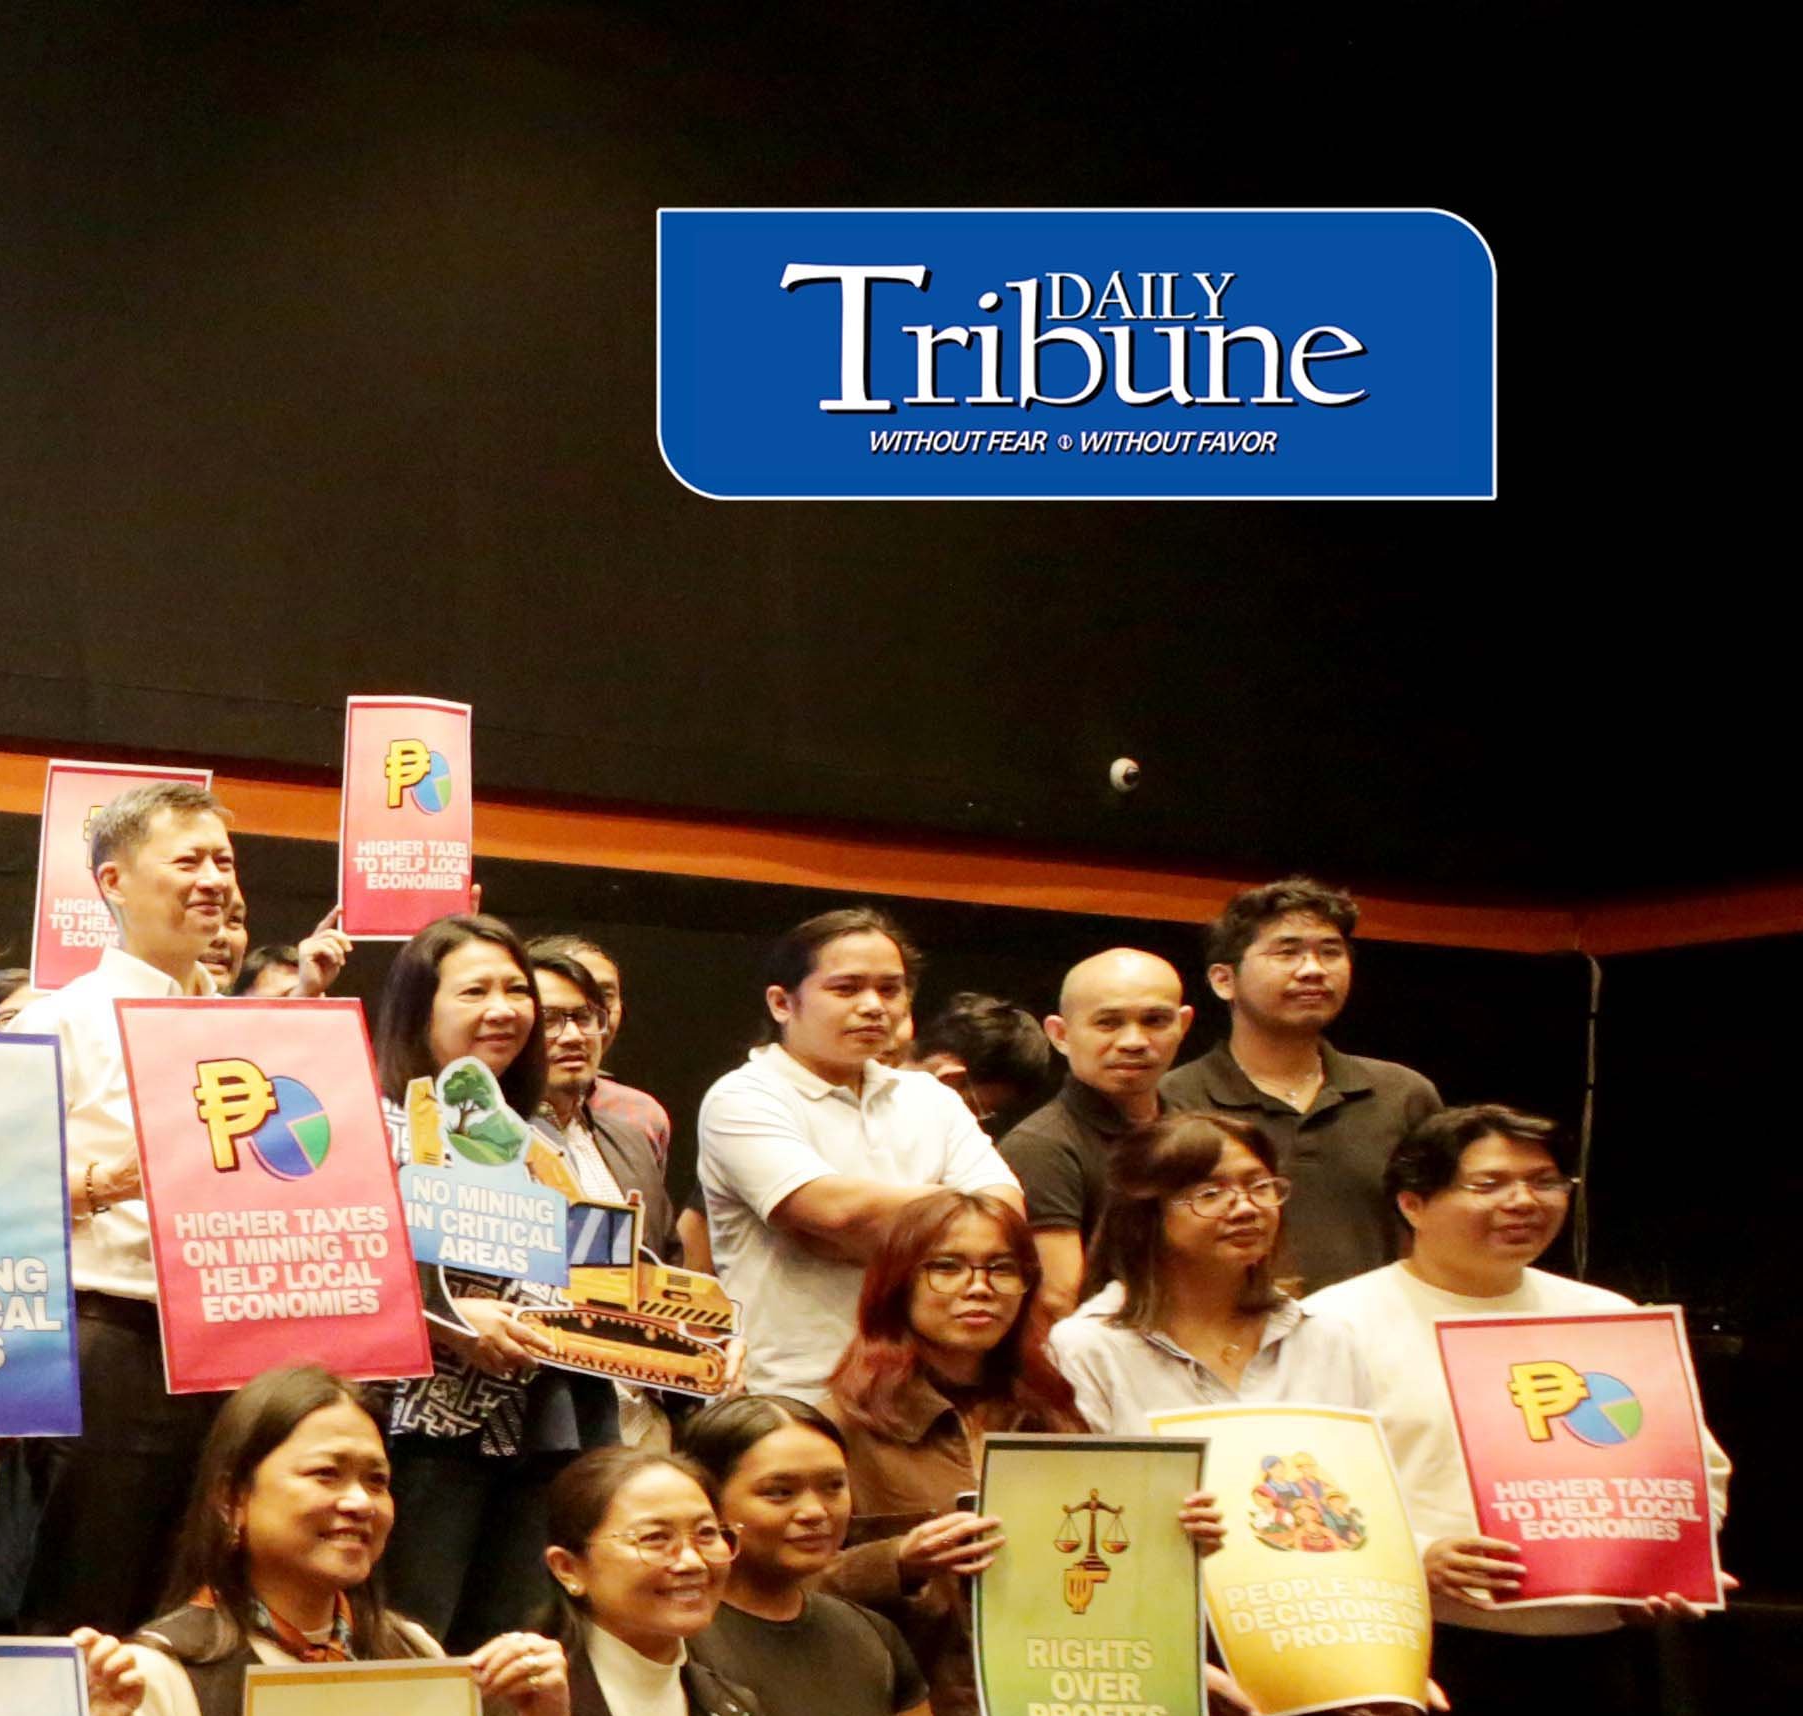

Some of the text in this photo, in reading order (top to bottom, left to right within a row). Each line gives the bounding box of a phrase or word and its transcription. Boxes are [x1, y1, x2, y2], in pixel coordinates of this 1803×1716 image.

[353, 856, 379, 873] TO
[382, 857, 426, 873] HELP
[366, 872, 463, 891] ECONOMIES
[49, 913, 118, 931] TO HEL
[412, 1174, 555, 1223] NO MINING
[174, 1206, 389, 1239] HIGHER TAXES
[406, 1200, 563, 1255] IN CRITICAL
[182, 1233, 388, 1267] ON MINING TO
[438, 1239, 529, 1274] AREAS
[199, 1260, 382, 1295] HELP LOCAL
[201, 1287, 380, 1322] ECONOMIES
[1493, 1478, 1694, 1500] HIGHER TAXES
[1492, 1500, 1701, 1523] TO HELP LOCAL
[1520, 1520, 1681, 1542] ECONOMIES
[1224, 1577, 1351, 1611] PEOPLE
[1027, 1637, 1154, 1670] RIGHTS
[1050, 1671, 1143, 1703] OVER
